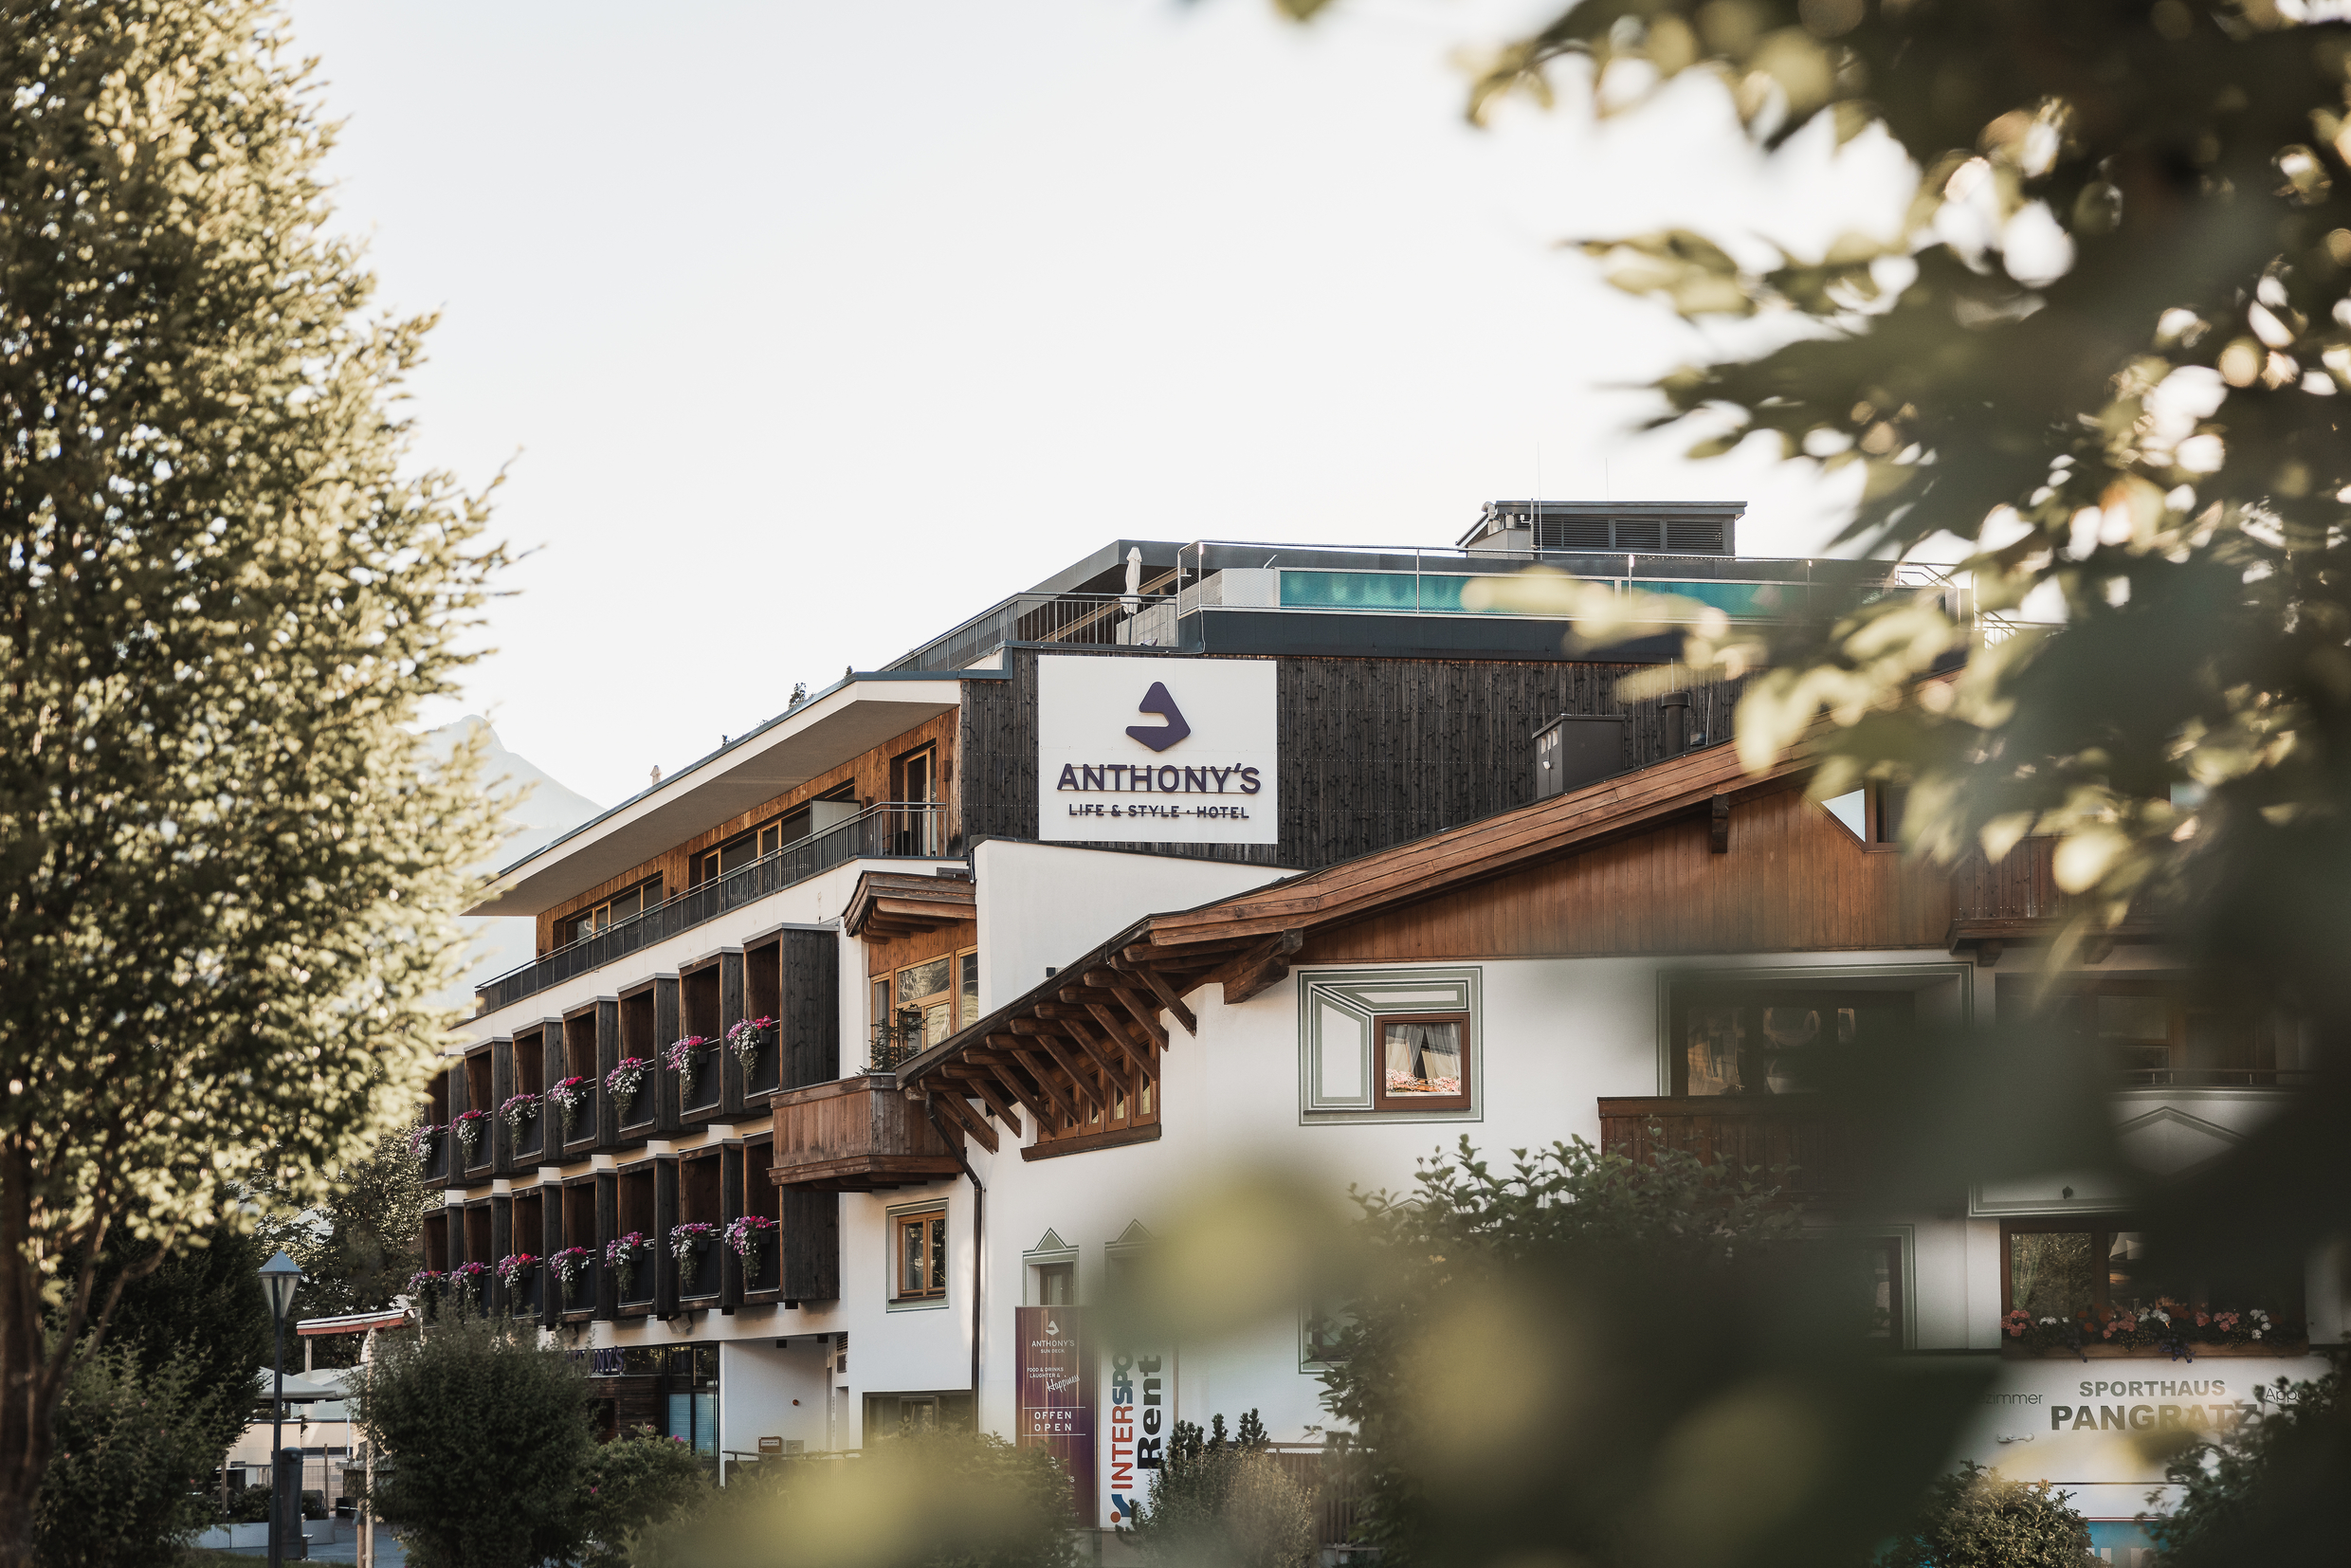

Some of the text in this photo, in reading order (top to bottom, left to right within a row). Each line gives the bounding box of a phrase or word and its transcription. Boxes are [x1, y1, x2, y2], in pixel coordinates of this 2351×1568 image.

[1057, 763, 1261, 793] ANTHONY'S
[1068, 804, 1104, 816] LIFE
[1110, 804, 1121, 817] &
[1127, 805, 1180, 817] STYLE
[1196, 806, 1249, 819] HOTEL
[1031, 1339, 1075, 1347] ANTHONY'S
[1046, 1374, 1080, 1393] Happiness
[2079, 1379, 2226, 1397] SPORTHAUS
[1034, 1411, 1071, 1420] OFFEN
[1111, 1351, 1133, 1489] INTERSPO
[1138, 1355, 1161, 1469] Rent
[2051, 1405, 2258, 1430] PANGRATZ
[1034, 1423, 1071, 1431] OPEN
